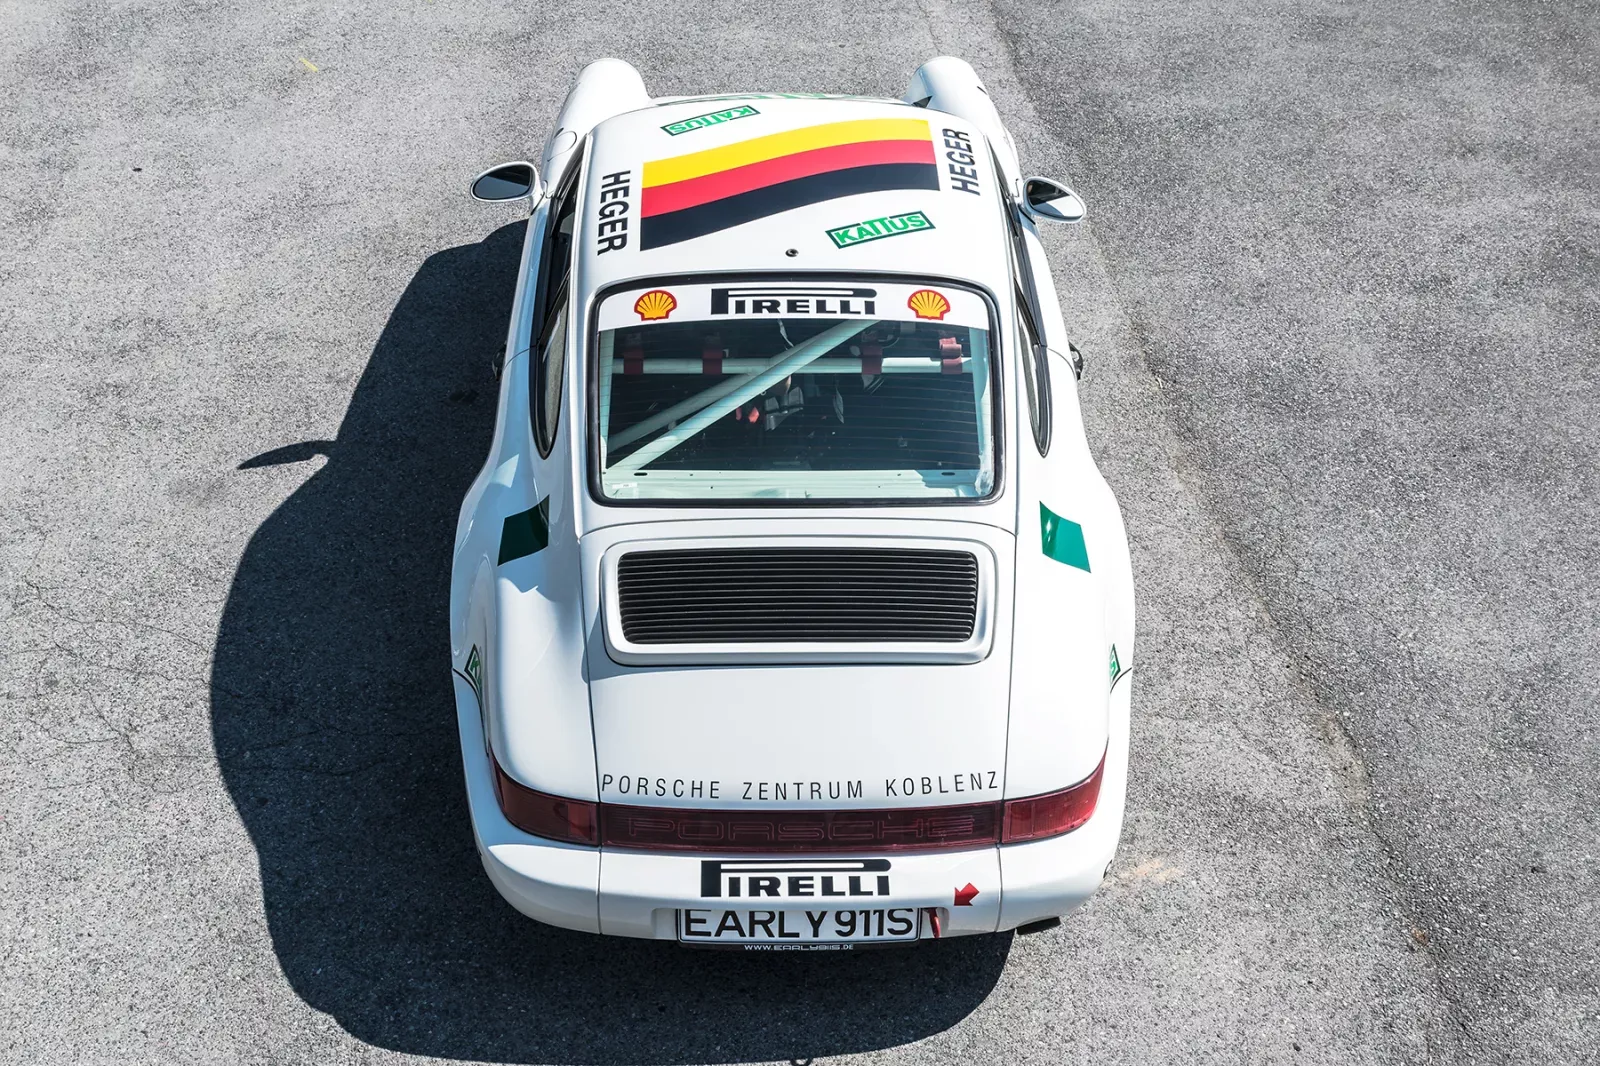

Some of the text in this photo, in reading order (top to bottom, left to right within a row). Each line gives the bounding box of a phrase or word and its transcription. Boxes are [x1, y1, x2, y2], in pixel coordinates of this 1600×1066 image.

[668, 107, 753, 133] KATTUS
[943, 127, 981, 197] HEGER
[597, 169, 631, 256] HEGER
[834, 215, 927, 244] KATTUS
[711, 287, 877, 315] PIRELLI
[601, 771, 1000, 799] PORSCHE ZENTRUM KOBLENZ
[628, 816, 975, 842] PORSCHE
[701, 858, 892, 898] PIRELLI
